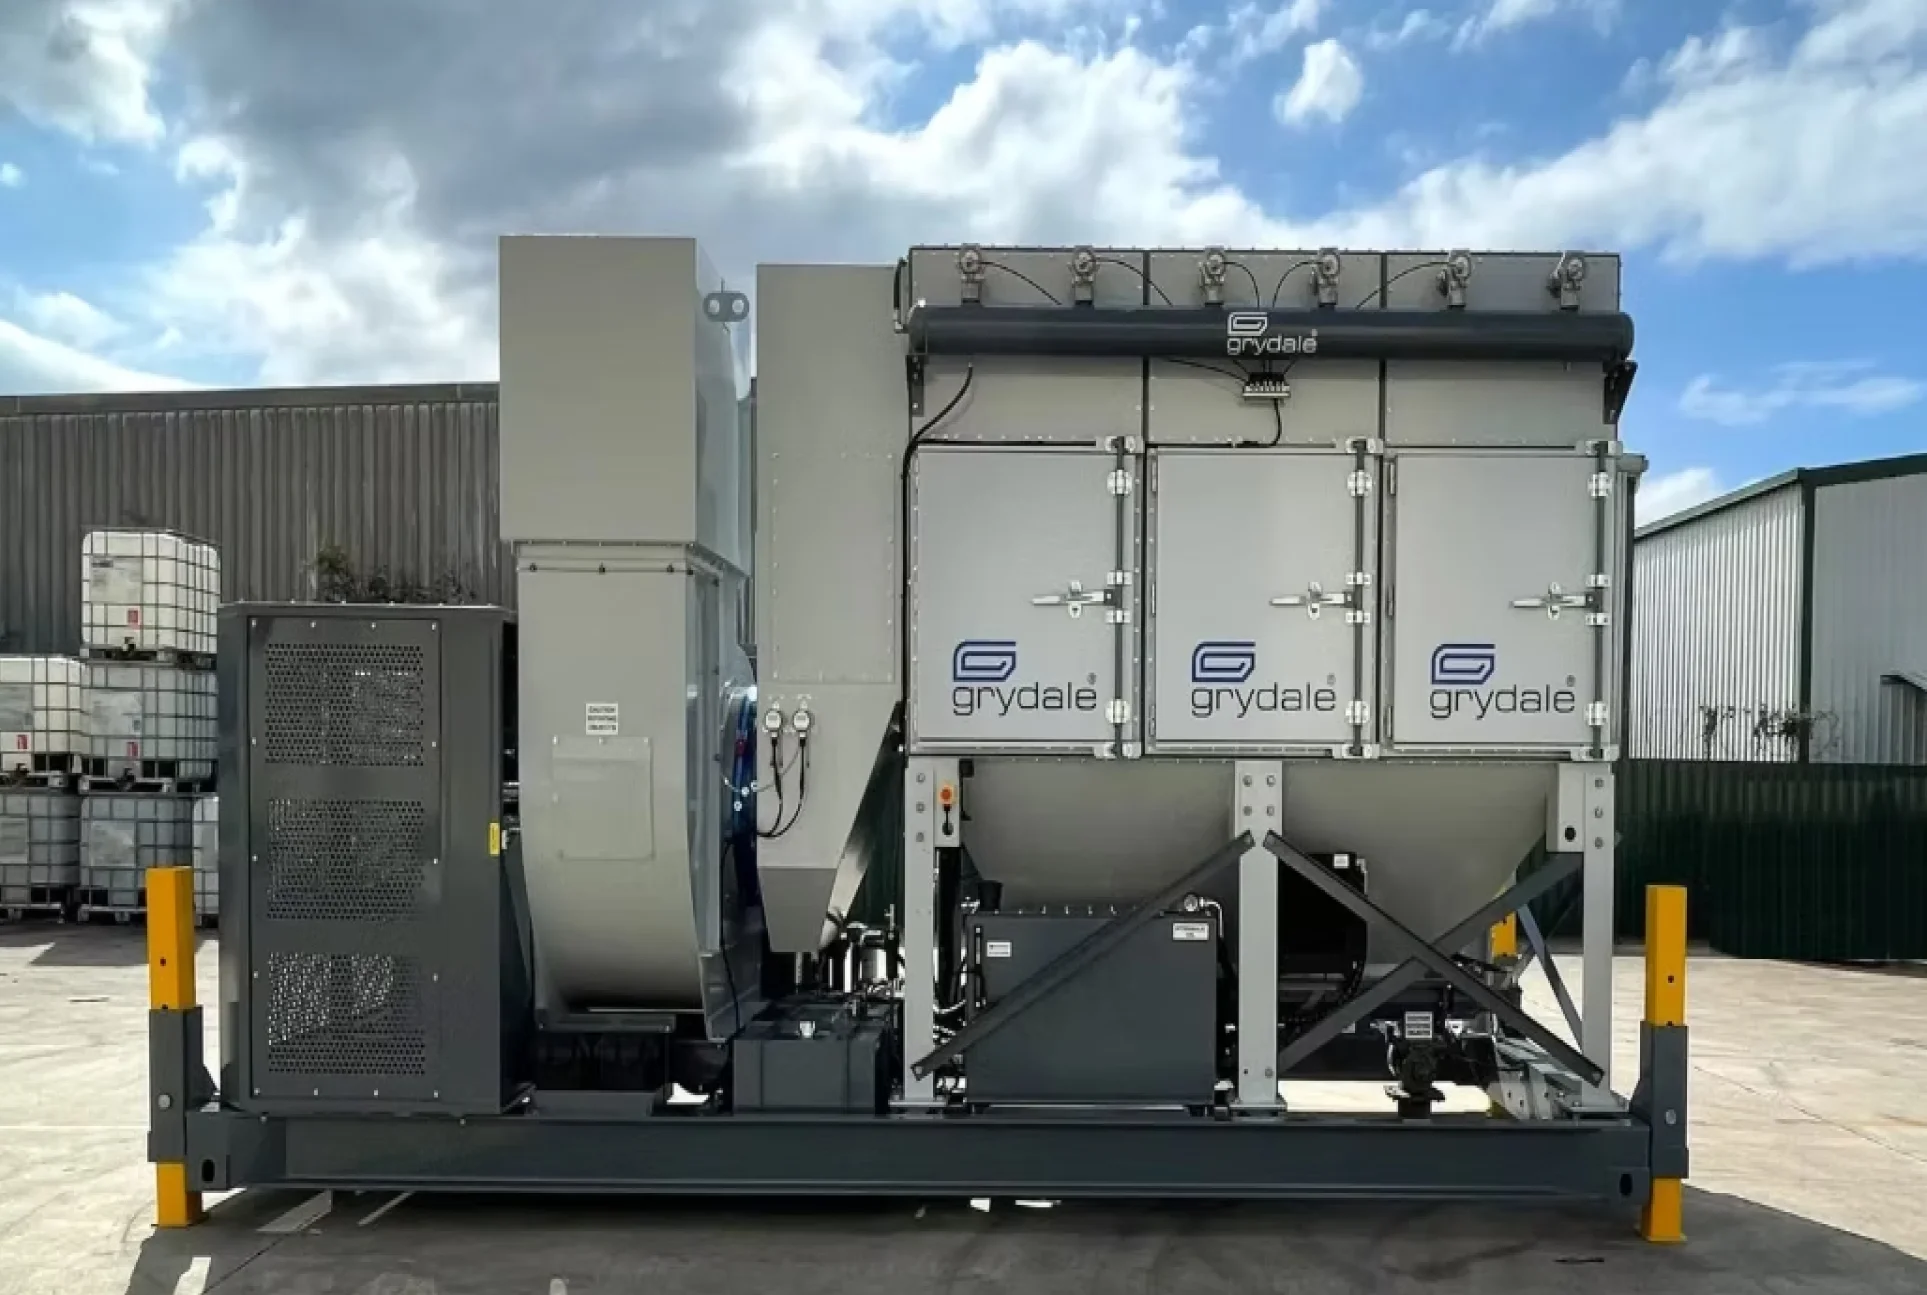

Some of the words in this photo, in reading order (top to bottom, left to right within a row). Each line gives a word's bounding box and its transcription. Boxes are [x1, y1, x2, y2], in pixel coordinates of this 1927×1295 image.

[953, 681, 1097, 716] grydale
[1191, 682, 1336, 718] grydale
[1430, 684, 1575, 720] grydale
